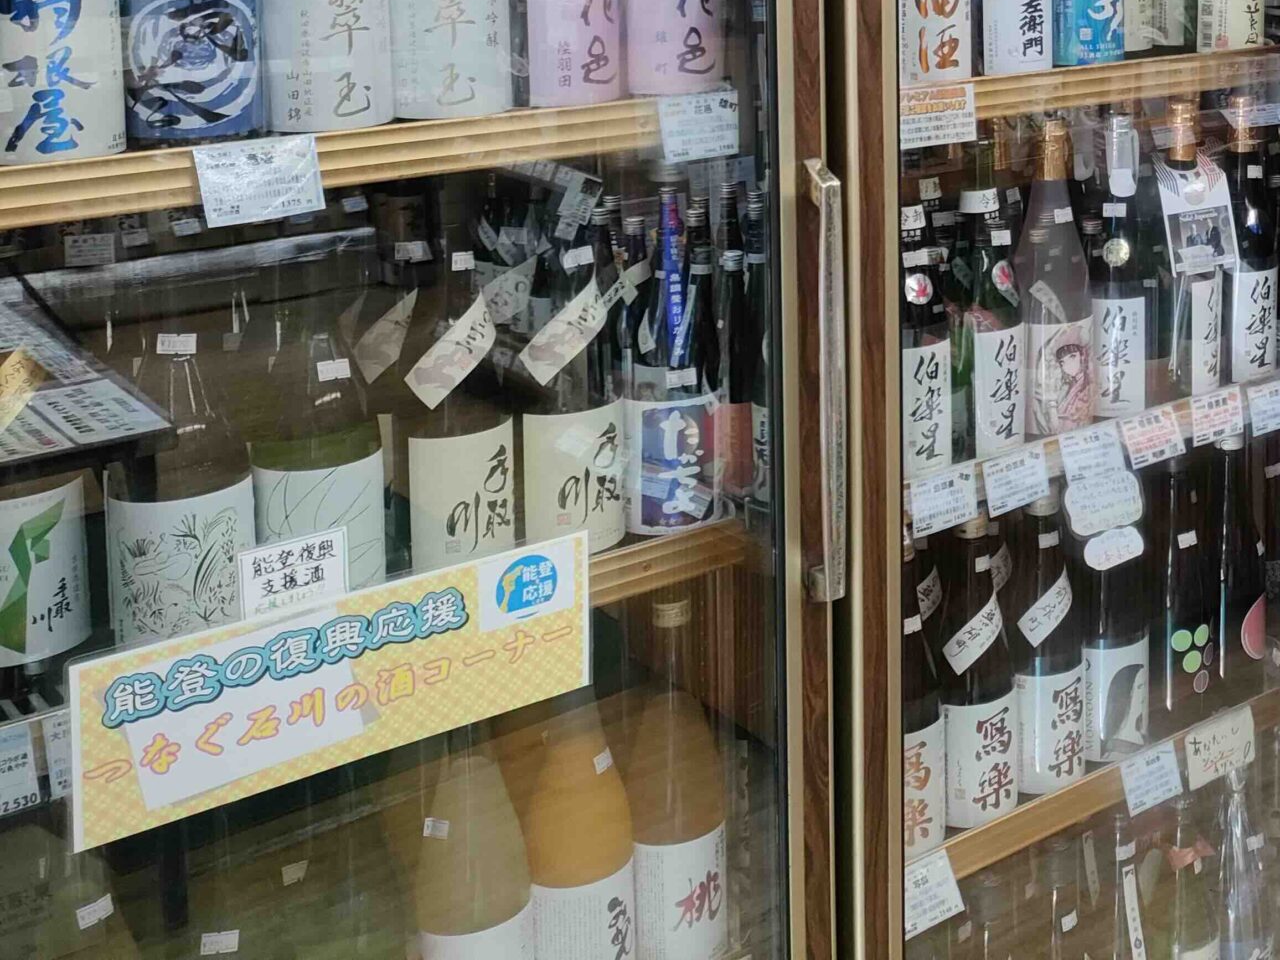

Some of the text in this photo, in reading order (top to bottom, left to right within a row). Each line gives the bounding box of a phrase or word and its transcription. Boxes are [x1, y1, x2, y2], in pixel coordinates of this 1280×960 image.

[252, 541, 336, 579] 能登復興
[522, 560, 553, 583] 能登
[261, 566, 326, 599] 支援酒
[102, 586, 470, 730] 能登の復興応援
[82, 624, 576, 784] つなぐ石川の酒コーナー
